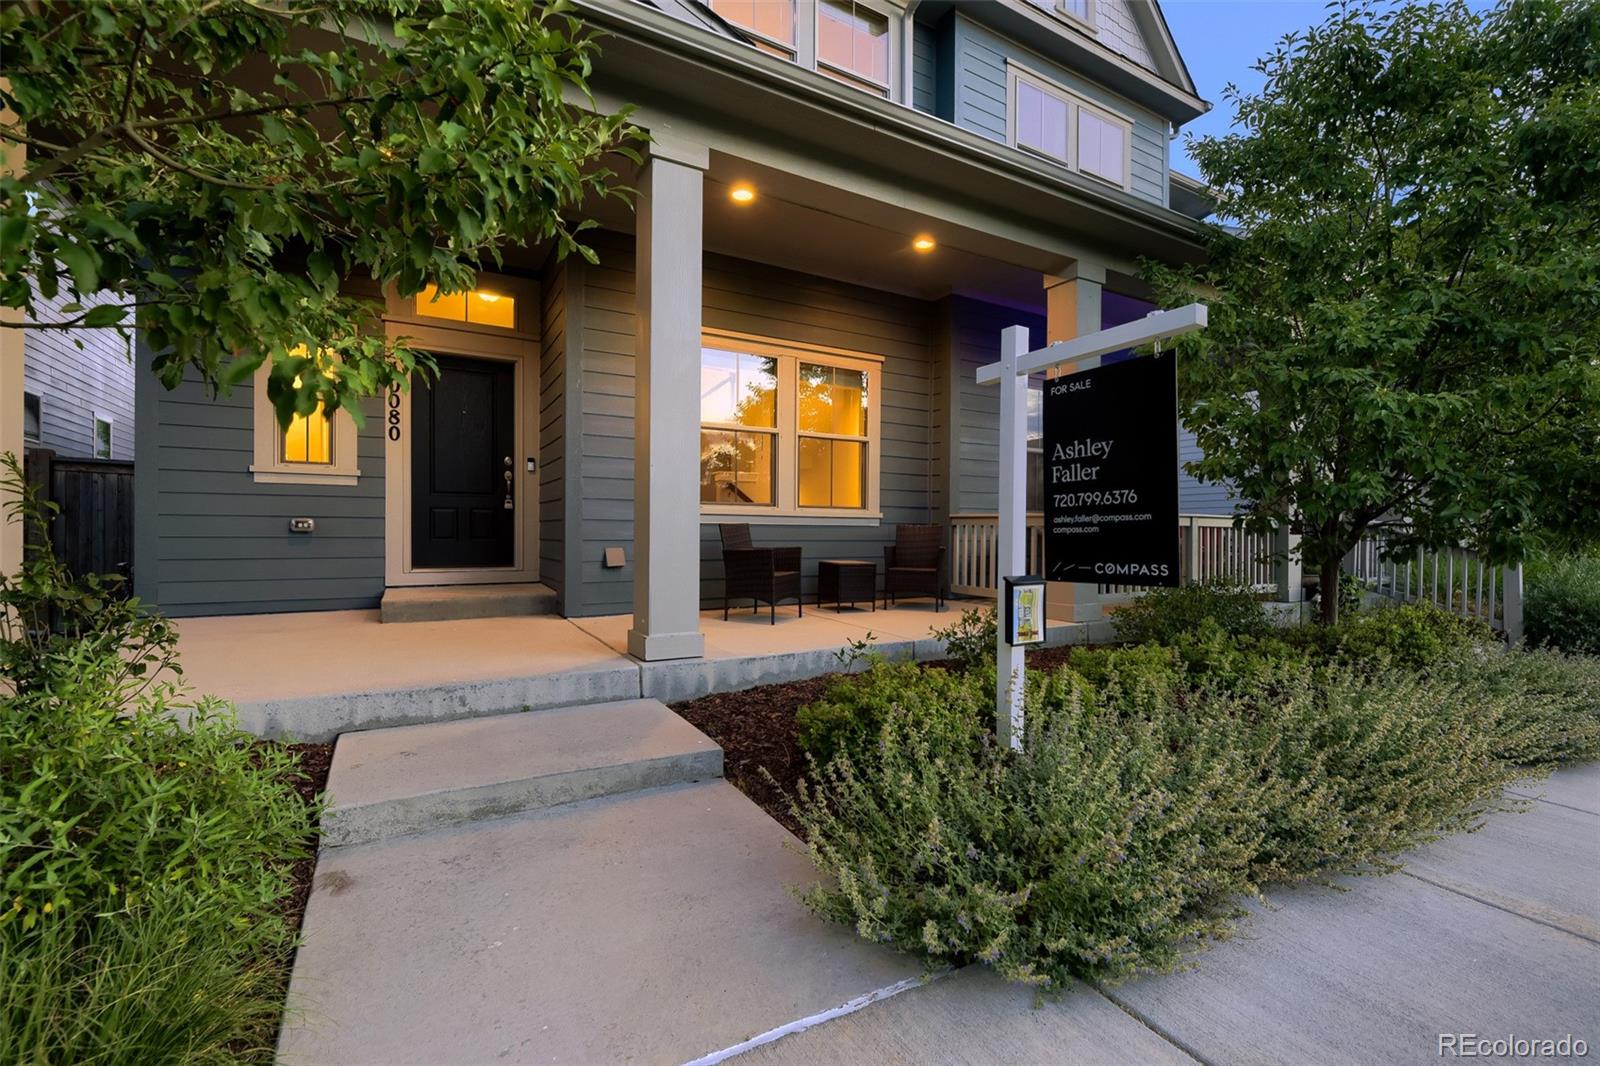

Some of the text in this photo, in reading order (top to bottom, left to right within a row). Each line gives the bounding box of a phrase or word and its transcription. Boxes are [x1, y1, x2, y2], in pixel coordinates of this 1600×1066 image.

[1050, 379, 1092, 396] FOR SALE
[1052, 438, 1114, 461] Ashley
[1052, 463, 1100, 483] Faller
[1053, 489, 1138, 508] 720.799.6376
[1053, 513, 1152, 524] ashley.faller@compass.com
[1053, 526, 1100, 535] compass.com
[1094, 562, 1169, 576] COMPASS
